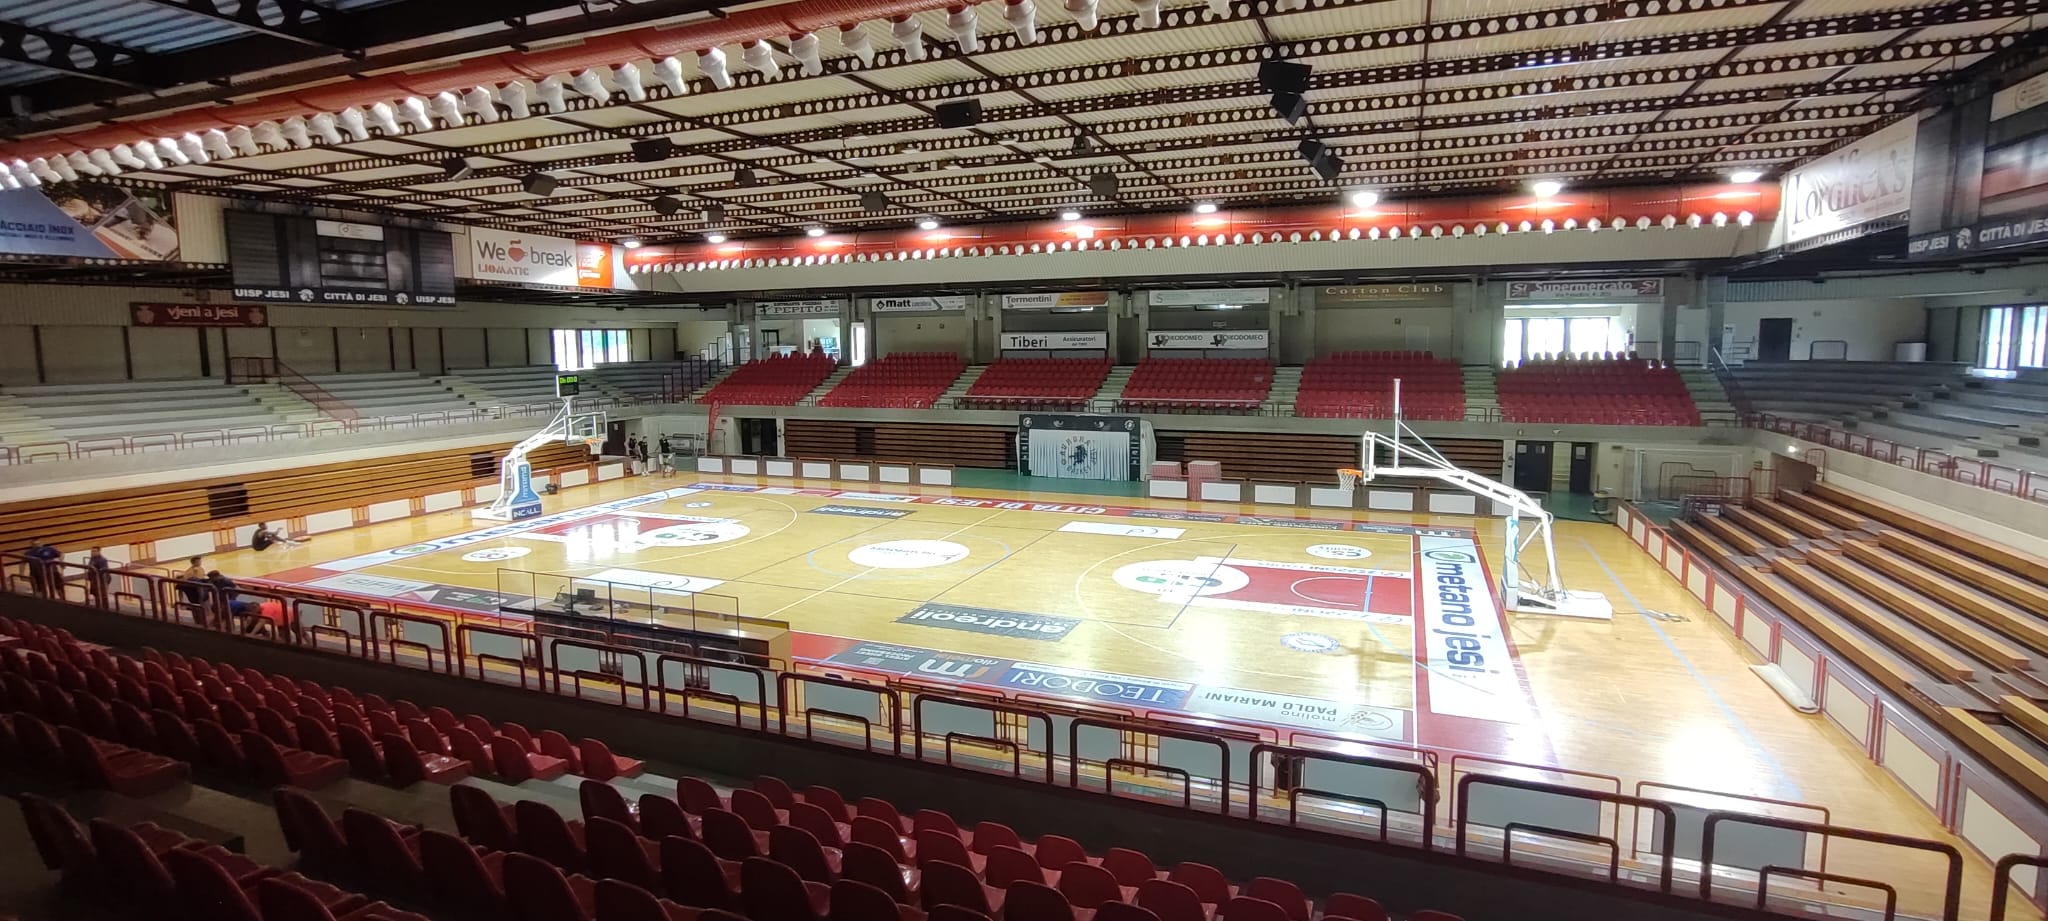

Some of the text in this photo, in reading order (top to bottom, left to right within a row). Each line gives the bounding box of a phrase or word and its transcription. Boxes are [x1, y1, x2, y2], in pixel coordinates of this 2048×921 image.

[1979, 222, 2011, 242] CITTÀ
[2012, 223, 2026, 237] DI
[1908, 236, 1949, 254] UISP JESI
[477, 239, 506, 261] We
[529, 246, 574, 268] break
[1325, 284, 1443, 295] Cotton Club
[1535, 280, 1633, 293] Supermercato
[235, 288, 290, 299] UISP JESI
[323, 291, 388, 302] CITTÀ DI JESI
[415, 295, 437, 304] UISP
[774, 305, 823, 314] PEPITO
[885, 299, 912, 308] matt
[1010, 335, 1048, 348] Tiberi
[933, 497, 994, 508] JESI
[994, 500, 1021, 510] DI
[909, 608, 1068, 634] andreoli
[1431, 562, 1501, 675] metano jesi
[1010, 671, 1166, 704] TEODORI
[1204, 691, 1338, 716] PAOLO MARIANI
[1280, 710, 1336, 723] molino
